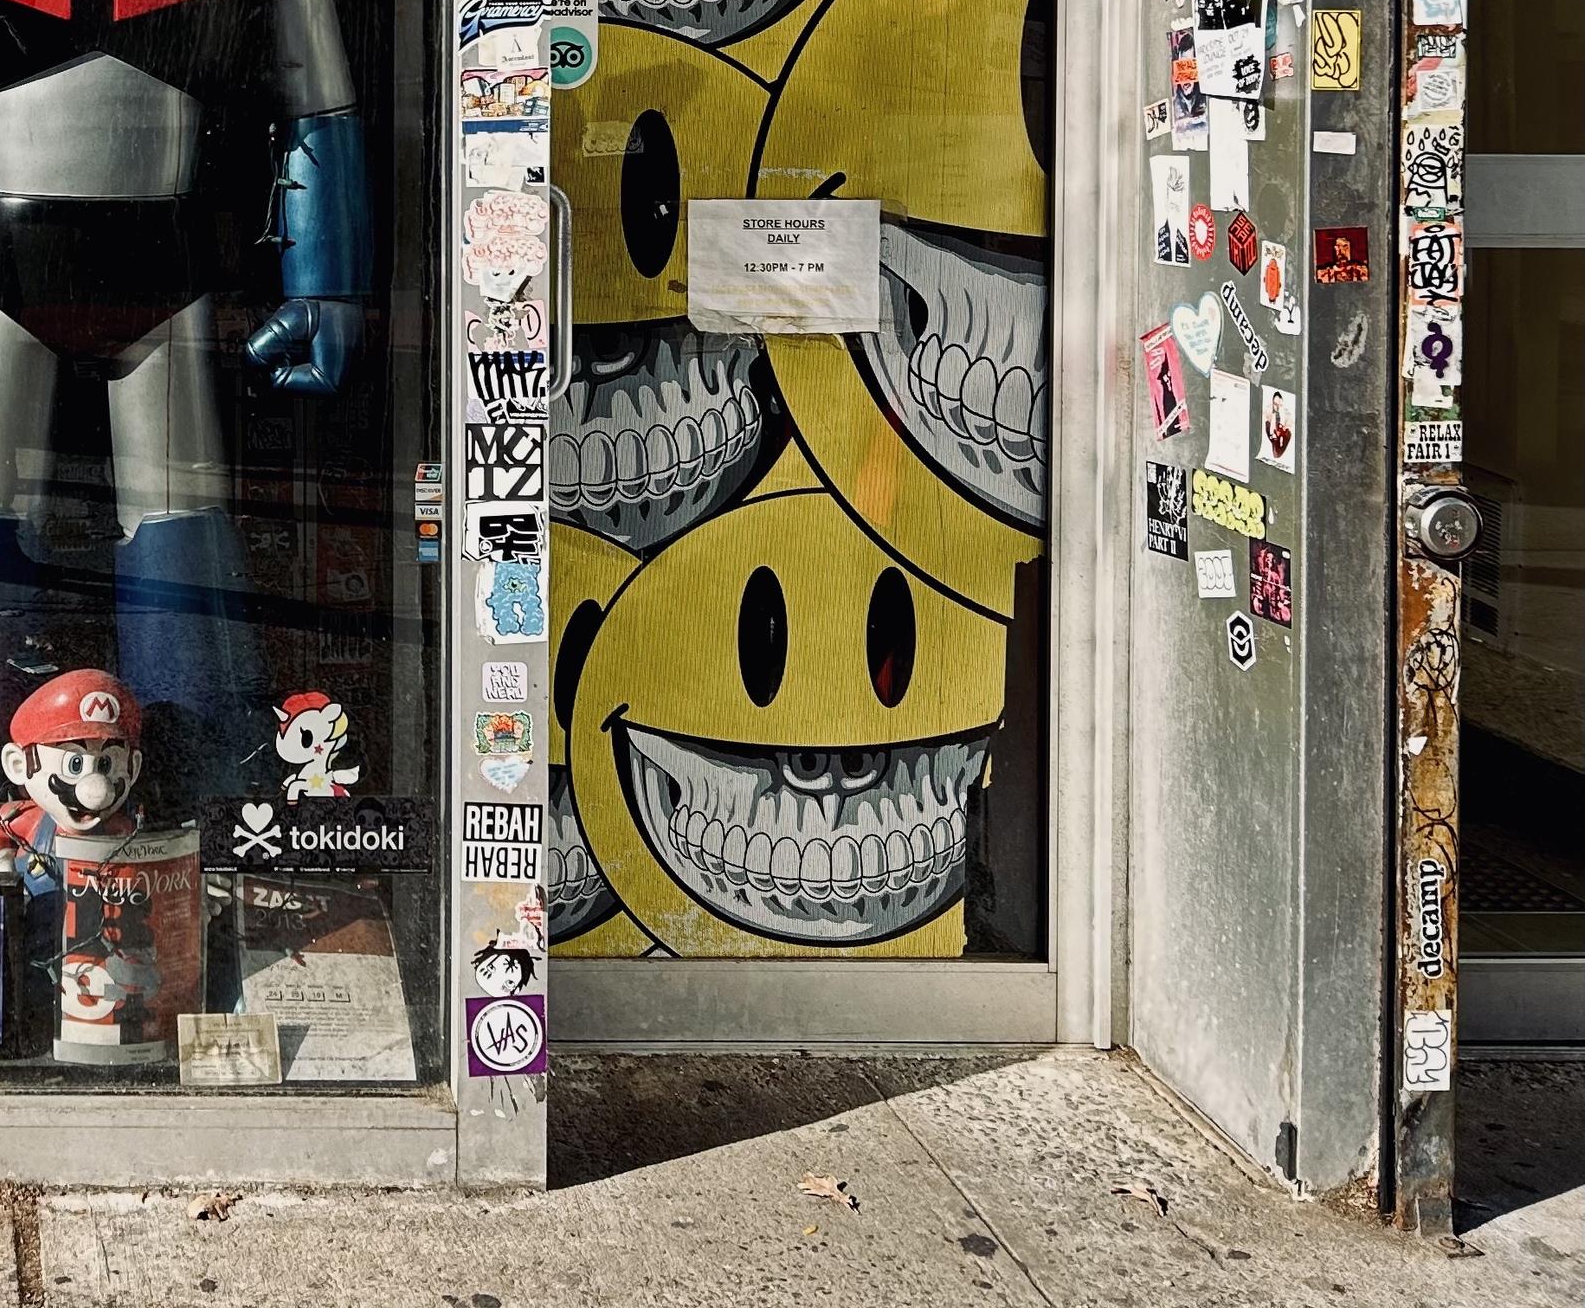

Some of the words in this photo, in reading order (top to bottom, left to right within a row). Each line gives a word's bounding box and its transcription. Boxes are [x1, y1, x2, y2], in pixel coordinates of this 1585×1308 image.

[573, 0, 587, 7] on
[742, 219, 781, 229] STORE
[784, 219, 826, 229] HOURS
[767, 234, 801, 244] DAILY
[798, 263, 805, 272] 7
[808, 263, 825, 272] PM
[1419, 423, 1462, 442] RELAX
[1407, 443, 1443, 460] FAIR
[419, 508, 440, 516] VISA
[1149, 517, 1175, 539] HENRY
[1149, 536, 1169, 554] PART
[86, 696, 114, 720] M
[465, 804, 539, 842] REBAH
[290, 825, 405, 851] tokidoki
[1418, 860, 1444, 980] decamp
